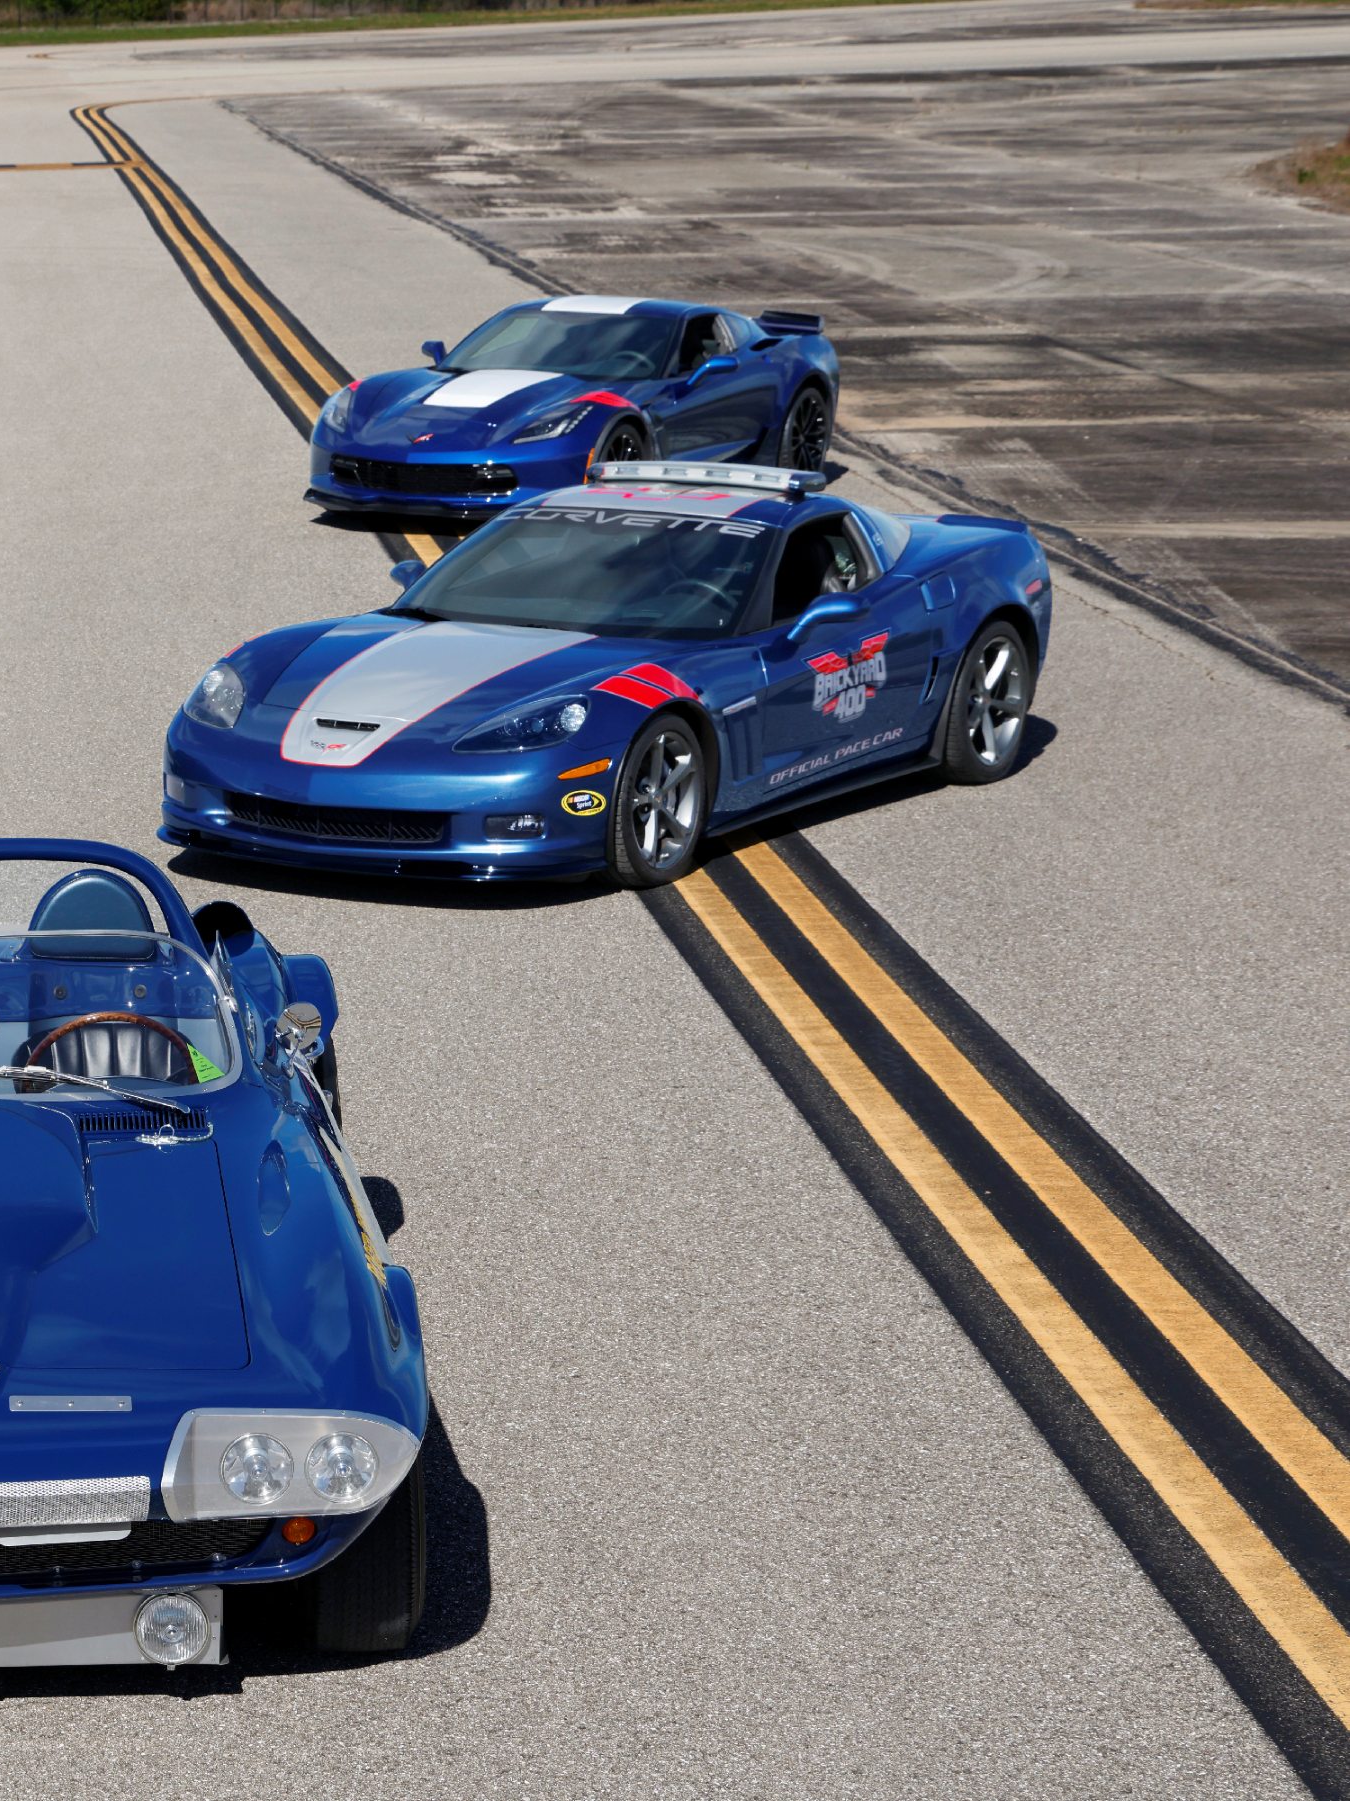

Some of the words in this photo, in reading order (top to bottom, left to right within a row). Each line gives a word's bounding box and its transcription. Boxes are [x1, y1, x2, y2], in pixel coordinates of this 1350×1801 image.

[496, 507, 765, 538] CORVETTE
[813, 651, 887, 711] BRICKYARD
[834, 684, 866, 723] 400
[769, 754, 832, 785] OFFICIAL
[834, 737, 871, 760] PACE
[872, 727, 904, 746] CAR
